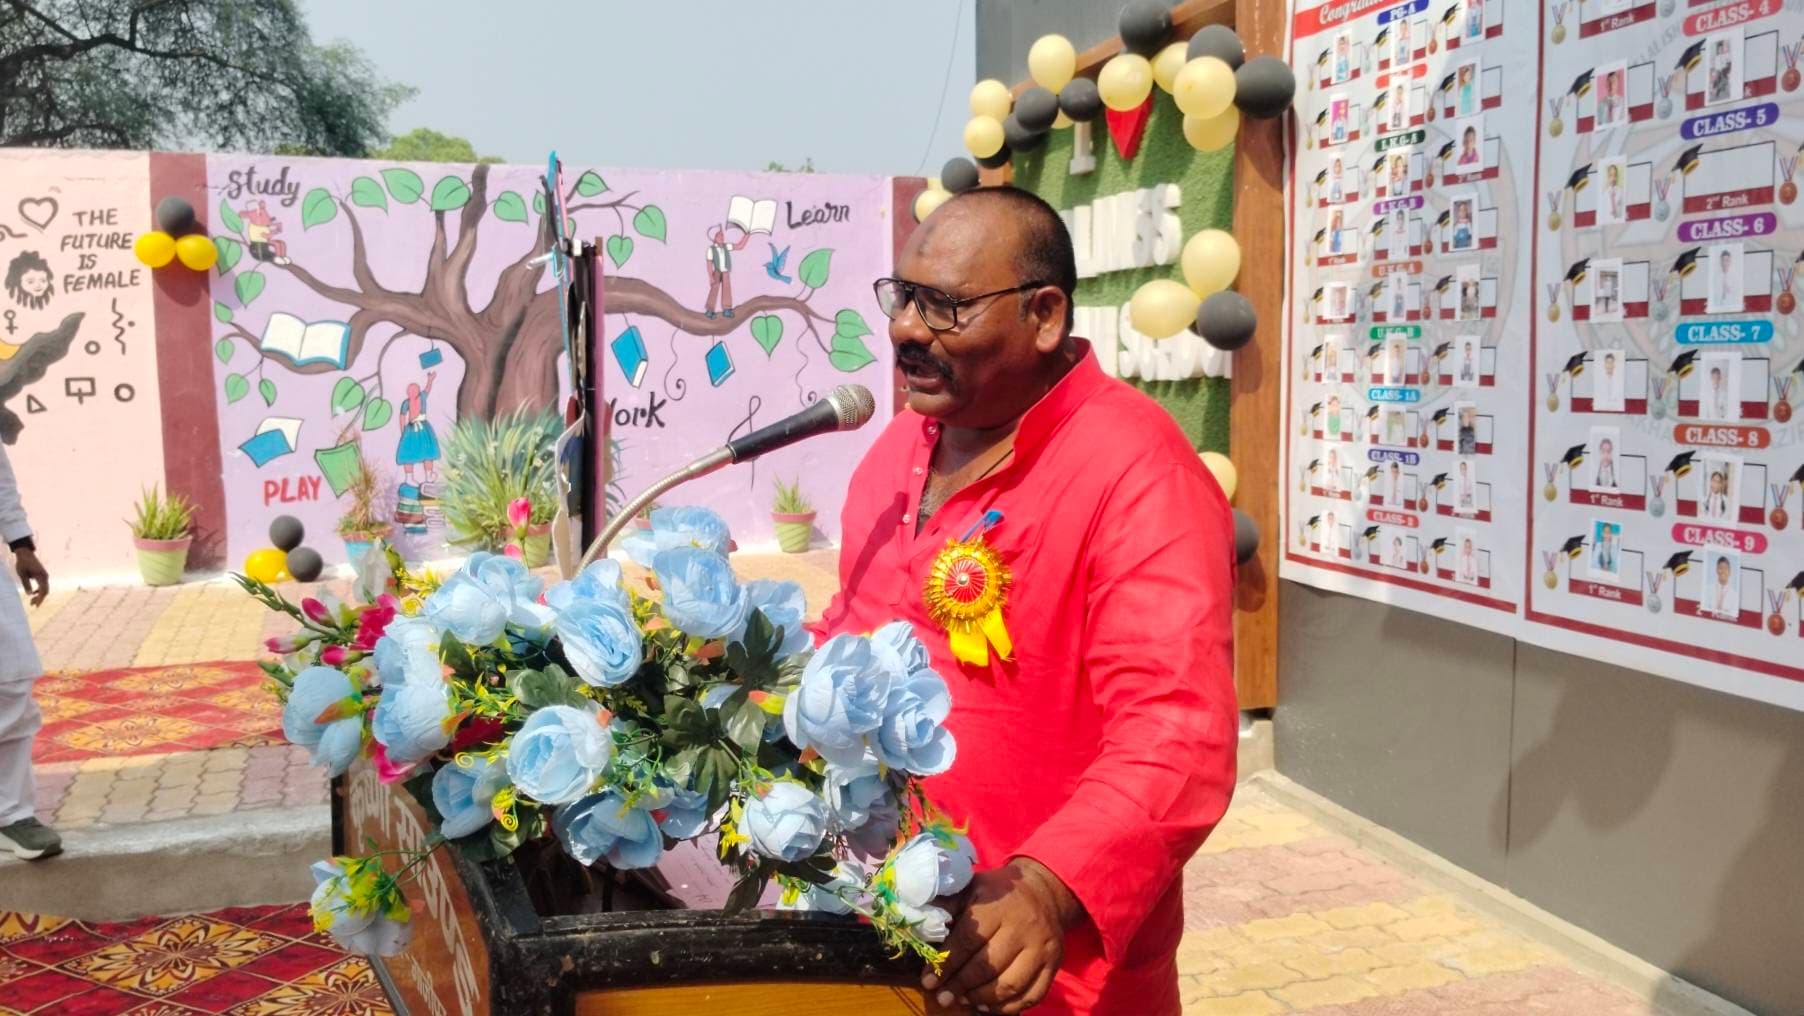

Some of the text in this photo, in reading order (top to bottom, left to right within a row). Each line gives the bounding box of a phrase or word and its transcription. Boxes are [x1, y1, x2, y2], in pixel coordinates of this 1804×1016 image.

[1612, 15, 1634, 28] Rank
[1696, 6, 1754, 32] CLASS-
[1759, 0, 1769, 15] 4
[1693, 109, 1766, 136] CLASS- 5
[227, 166, 301, 207] Study
[1722, 194, 1749, 207] Rank
[72, 208, 118, 227] THE
[786, 201, 850, 230] Learn
[1690, 217, 1764, 240] CLASS- 6
[60, 231, 133, 252] FUTURE
[78, 253, 97, 270] IS
[63, 269, 141, 293] FEMALE
[1688, 325, 1761, 342] CLASS- 7
[610, 391, 667, 428] ork
[1685, 427, 1744, 444] CLASS-
[1747, 431, 1759, 446] 8
[263, 476, 322, 506] PLAY
[1601, 495, 1623, 507] Rank
[1683, 527, 1755, 550] CLASS- 9
[1598, 587, 1621, 599] Rank
